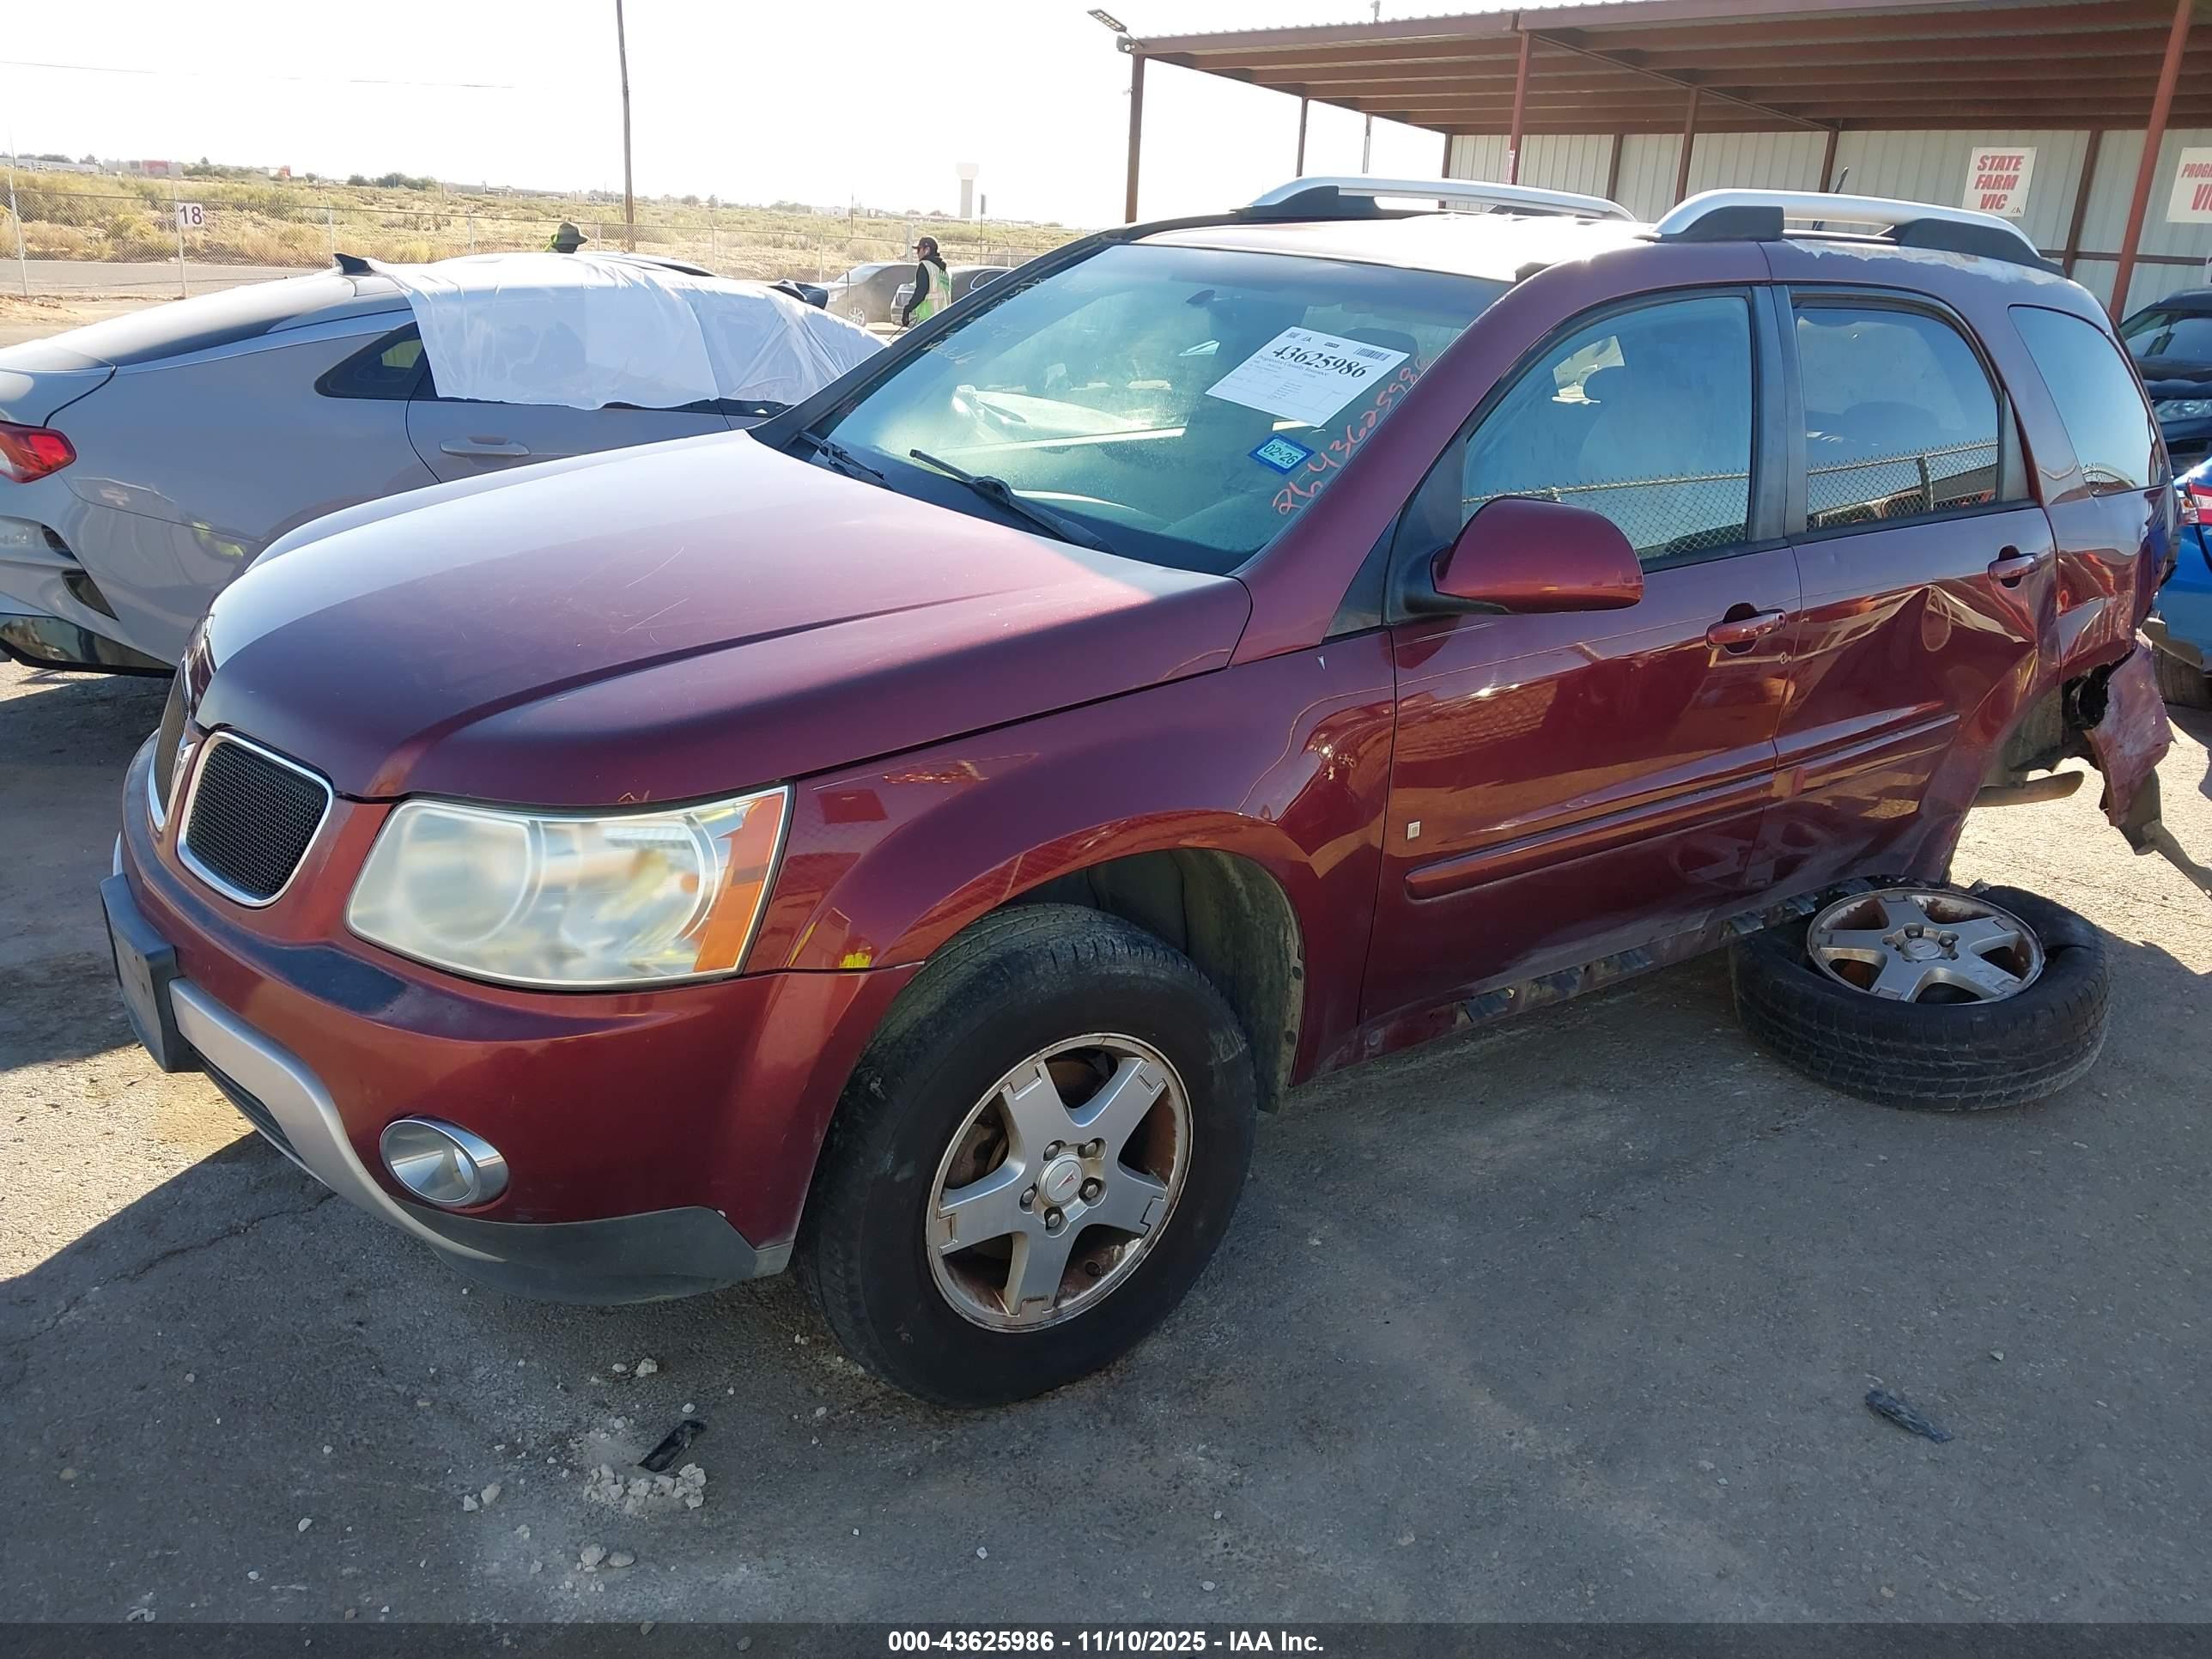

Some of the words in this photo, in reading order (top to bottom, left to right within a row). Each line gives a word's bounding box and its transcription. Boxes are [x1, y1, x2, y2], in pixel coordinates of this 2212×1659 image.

[1977, 155, 2025, 171] STATE
[1974, 174, 2020, 190] FARM
[1980, 194, 2008, 210] VIC
[179, 205, 203, 225] 18
[1272, 345, 1375, 379] 43625986
